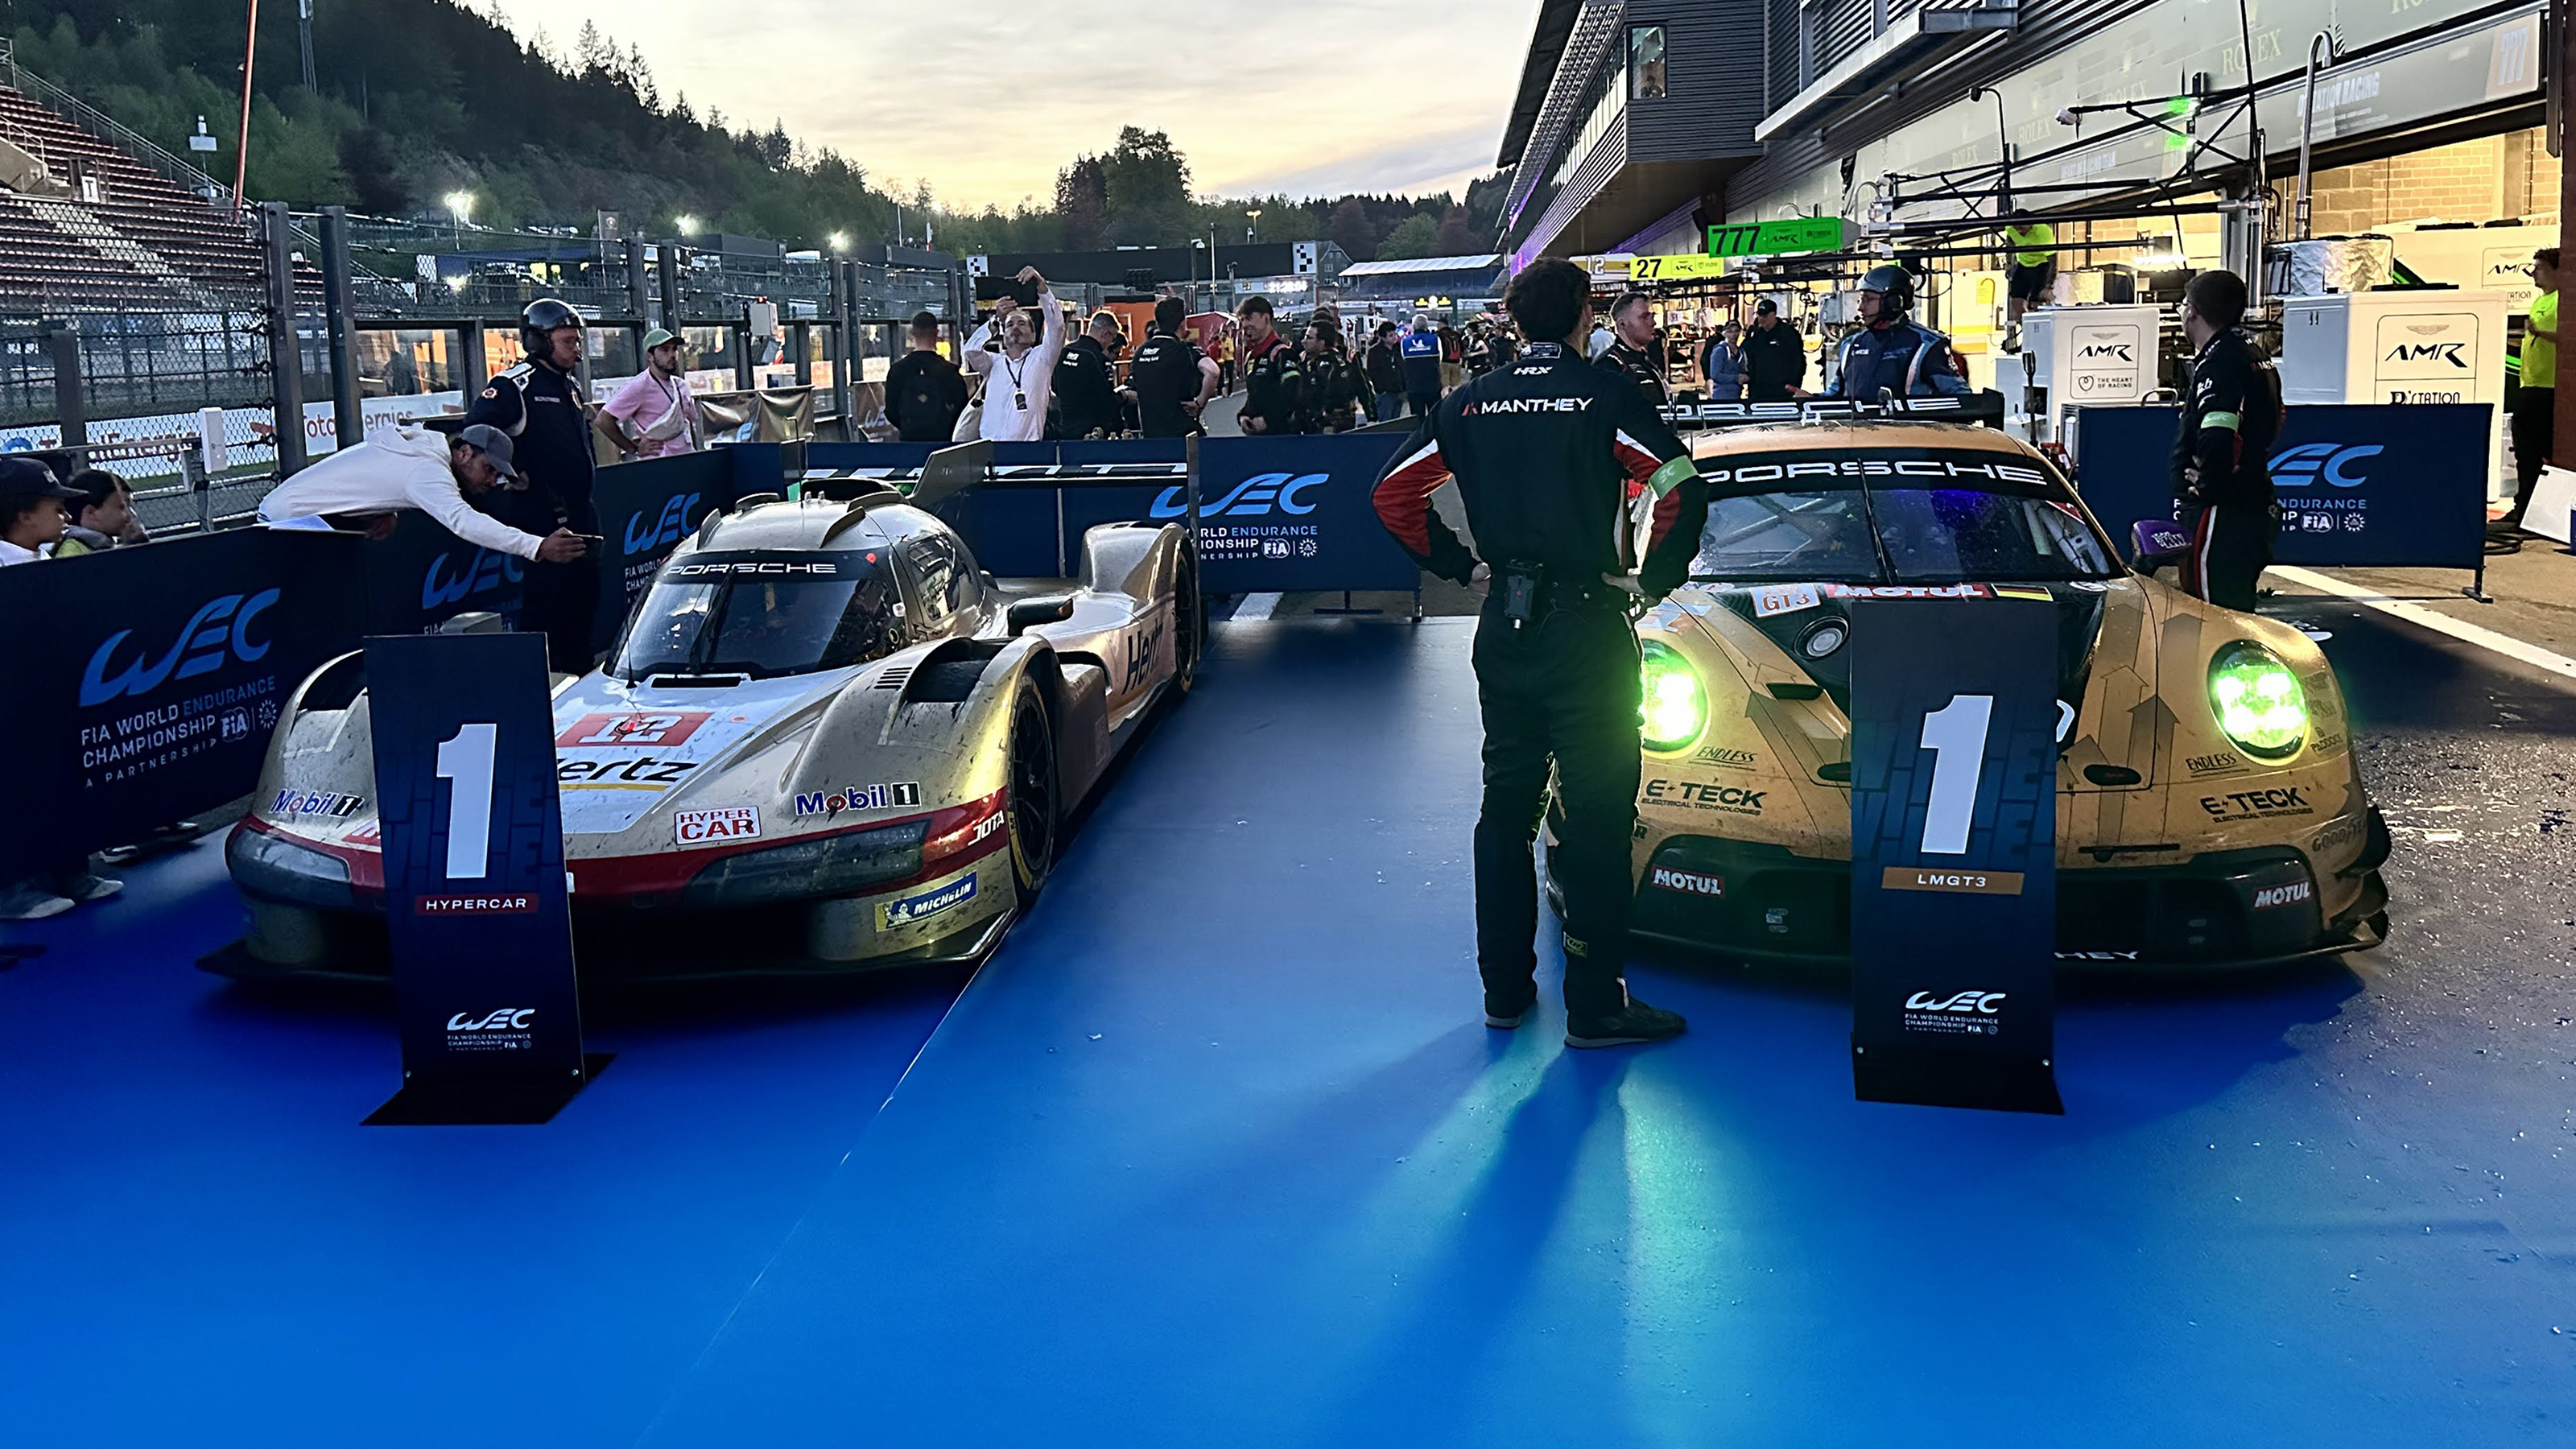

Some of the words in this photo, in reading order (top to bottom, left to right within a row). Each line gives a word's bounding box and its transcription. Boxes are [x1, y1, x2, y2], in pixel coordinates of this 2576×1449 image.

[2018, 120, 2051, 147] ROLEX
[85, 180, 94, 198] T
[1712, 226, 1761, 254] 777
[1586, 256, 1605, 275] 12
[1637, 259, 1662, 279] 27
[2077, 345, 2133, 361] AMR
[2385, 343, 2467, 368] AMR
[1481, 398, 1593, 415] MANTHEY
[1657, 398, 1962, 417] ORSCHE
[1704, 460, 2047, 485] PORSCHE
[2267, 443, 2384, 487] EC
[1150, 473, 1330, 518] WEC
[2277, 499, 2367, 509] NDURANCE
[624, 493, 700, 555] WEC
[1200, 527, 1227, 537] RLD
[1232, 526, 1318, 537] ENDURANCE
[1200, 538, 1259, 550] IONSHIP
[1200, 552, 1258, 560] NERSHIP
[625, 566, 636, 578] FIA
[664, 564, 837, 576] PORSCHE
[1835, 584, 1983, 597] MOTUL
[1763, 592, 1810, 612] GT3
[79, 588, 281, 707] WEC
[81, 724, 111, 746] FIA
[117, 704, 180, 737] WORLD
[184, 675, 276, 716] ENDURANCE
[84, 714, 216, 768] CHAMPIONSHIP
[84, 778, 94, 789] A
[105, 738, 217, 783] PARTNERSHIP
[1696, 745, 1758, 763] ENDLESS
[2185, 753, 2237, 770] ENDLESS
[557, 757, 699, 782] ertz
[1921, 695, 1993, 854] 1
[270, 789, 338, 815] Mobil
[437, 723, 497, 879] 1
[795, 783, 887, 815] Mobil
[1641, 798, 1691, 808] ELECTRICAL
[1694, 802, 1761, 815] TECHNOLOGIES
[680, 808, 750, 824] HYPER
[2213, 812, 2259, 824] ELECTRICAL
[2260, 807, 2314, 819] TECHNOLOGIES
[680, 818, 754, 840] CAR
[968, 810, 1005, 846] JOTA
[1653, 868, 1722, 895] MOTUL
[1918, 873, 1987, 887] LMGT3
[426, 898, 527, 910] HYPERCAR
[914, 881, 972, 914] MICHELIN
[2255, 882, 2310, 907] MOTUL
[1905, 991, 2006, 1013] WEC
[447, 1009, 535, 1030] WEC
[1905, 1019, 1966, 1028] CHAMPIONSHIP
[1951, 1016, 1999, 1024] ENDURANCE
